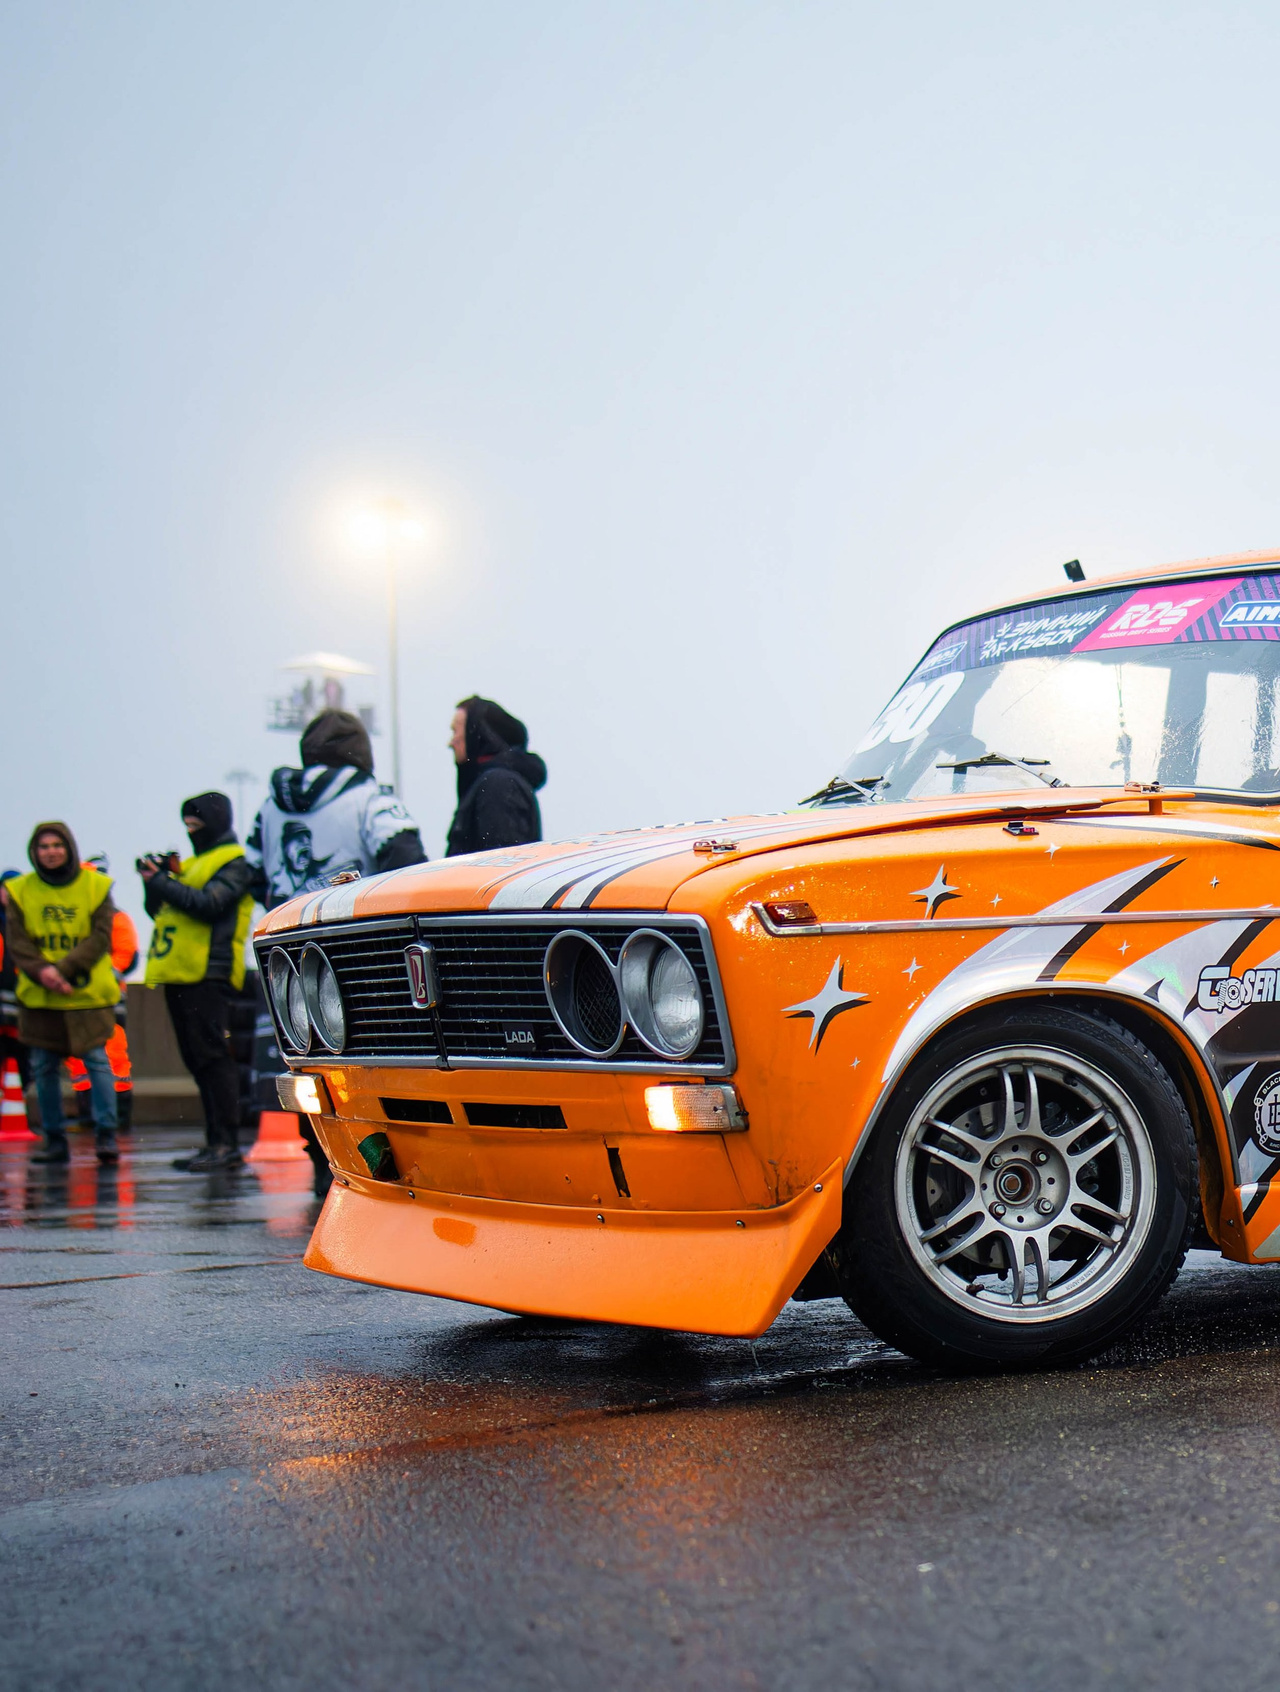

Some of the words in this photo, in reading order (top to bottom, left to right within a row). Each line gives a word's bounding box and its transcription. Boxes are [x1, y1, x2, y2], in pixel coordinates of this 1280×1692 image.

[1004, 603, 1108, 639] ЗИМНИЙ
[1107, 598, 1204, 632] RDS
[1004, 627, 1088, 653] КУБОК
[855, 671, 965, 754] 30
[504, 1031, 535, 1044] LADA
